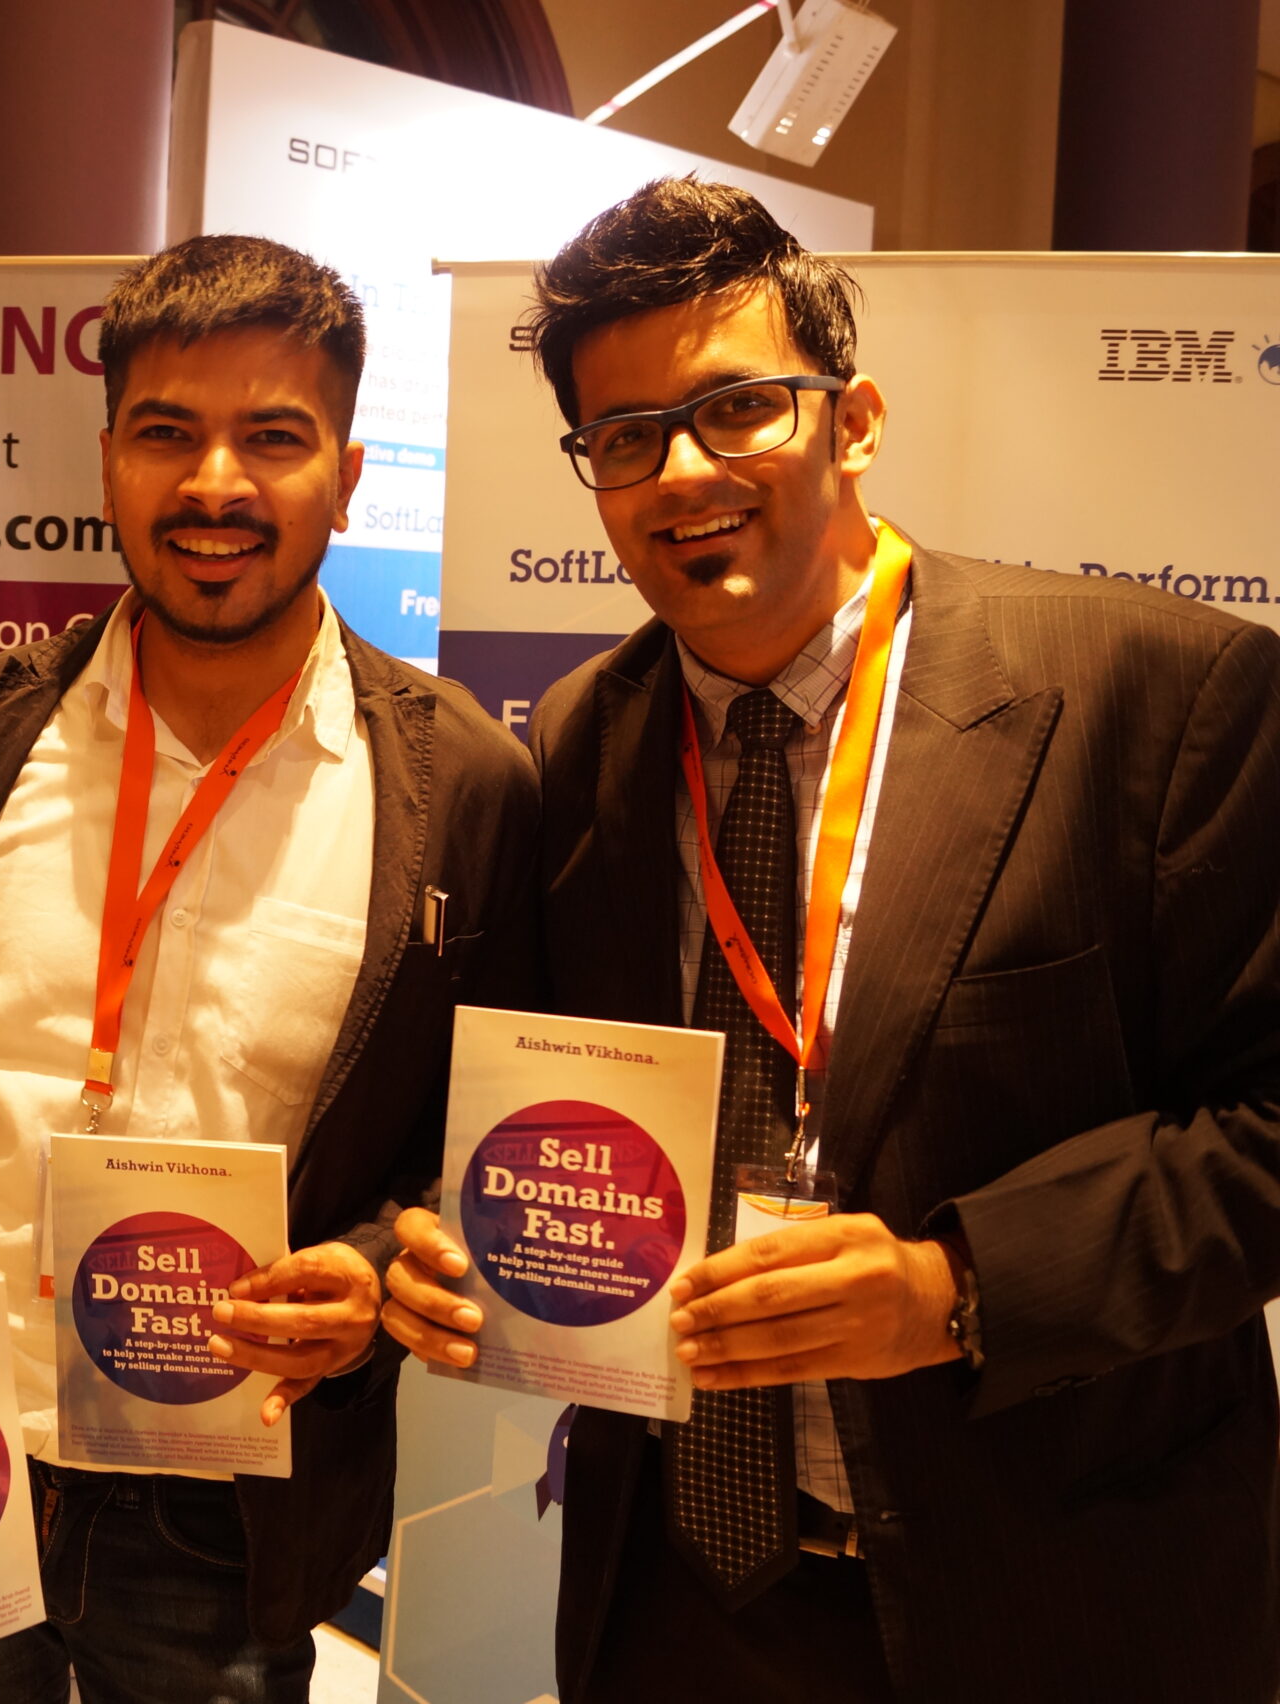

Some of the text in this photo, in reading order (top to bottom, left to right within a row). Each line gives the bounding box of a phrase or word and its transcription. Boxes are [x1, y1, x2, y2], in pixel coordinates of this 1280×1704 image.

[1098, 329, 1236, 383] IBM
[397, 446, 436, 467] demo
[515, 1036, 659, 1066] Aishwin Vikhona.
[105, 1158, 233, 1177] Aishwin Vikhona.
[538, 1137, 612, 1177] Sell
[483, 1165, 664, 1220] Domains
[522, 1207, 616, 1250] Fast.
[137, 1245, 203, 1274] Sell
[487, 1252, 651, 1288] to help you make more money
[513, 1243, 624, 1269] A step-by-step guide
[498, 1266, 636, 1298] by selling domain names
[130, 1306, 213, 1338] Fast.
[102, 1348, 113, 1358] to
[113, 1348, 136, 1360] help
[137, 1351, 155, 1361] you
[156, 1351, 184, 1362] make
[185, 1354, 211, 1364] more
[125, 1338, 133, 1348] A
[134, 1340, 193, 1353] step-by-step
[114, 1359, 235, 1377] by selling domain names
